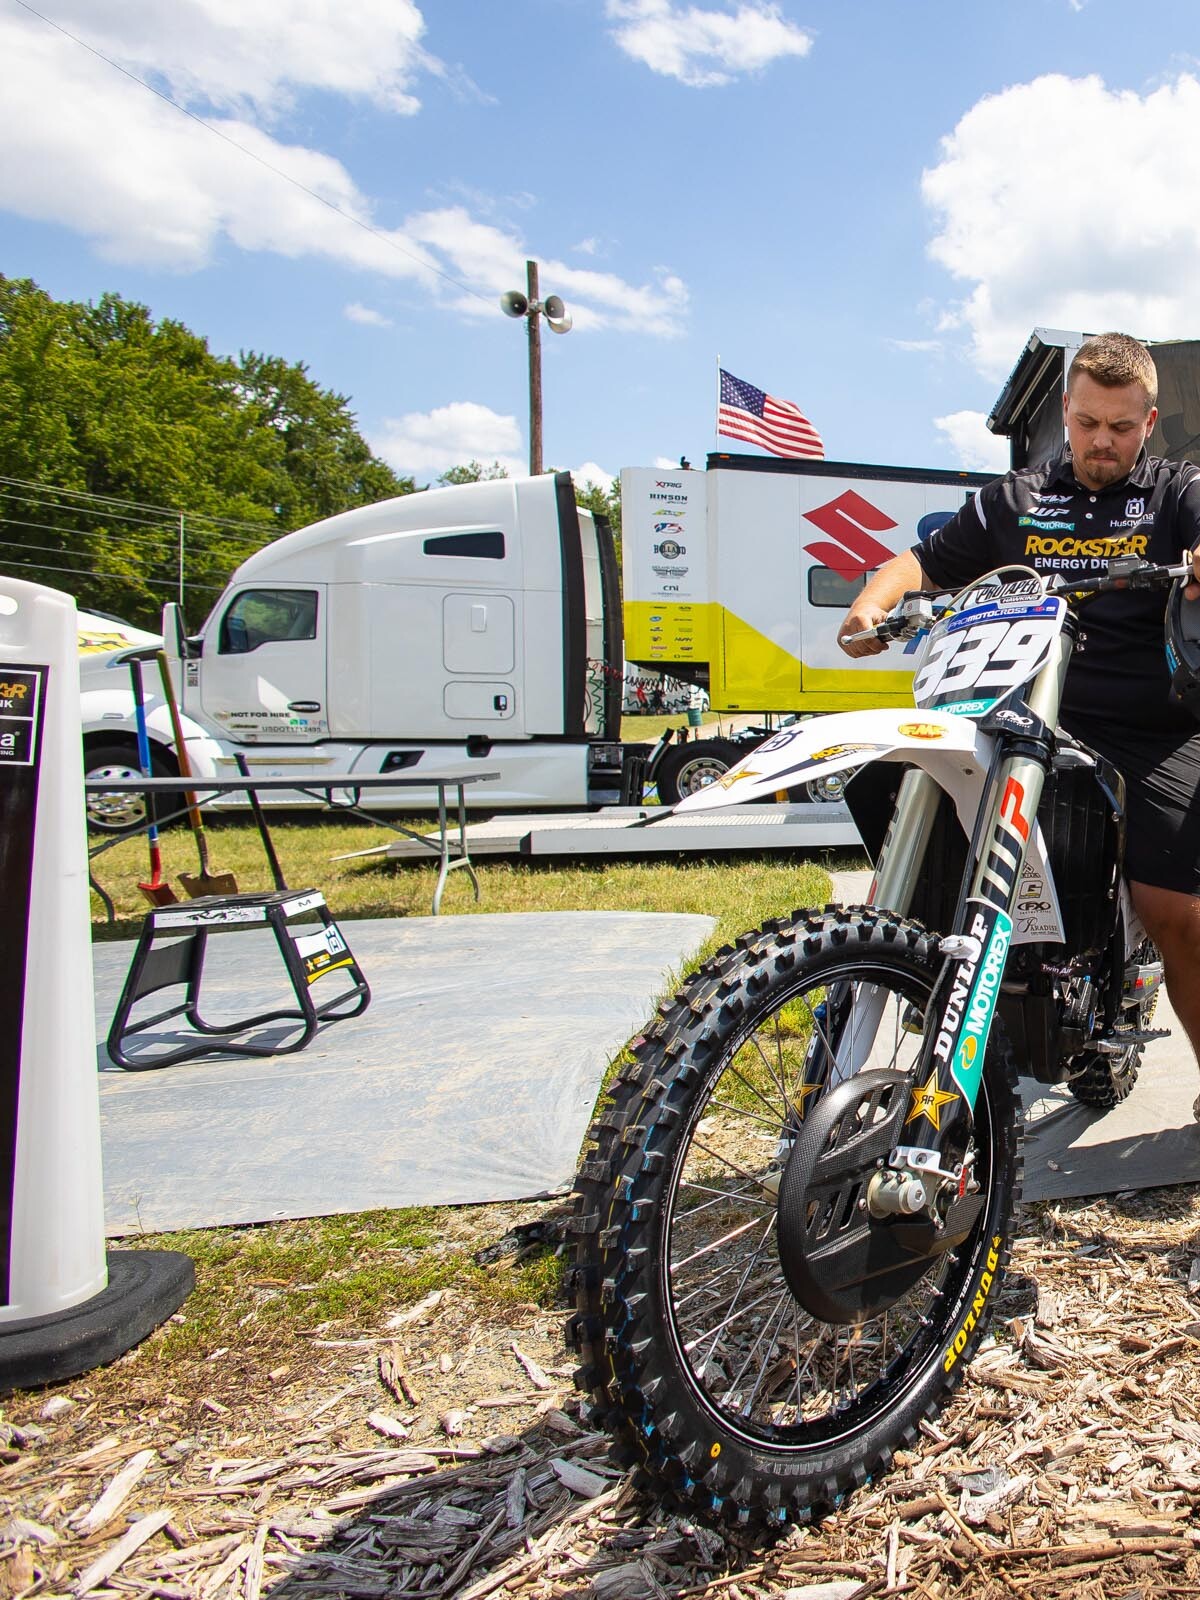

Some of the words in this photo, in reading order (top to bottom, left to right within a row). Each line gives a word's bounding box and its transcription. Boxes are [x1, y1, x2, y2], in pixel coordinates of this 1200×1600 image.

[655, 480, 683, 489] XTRIG
[649, 493, 688, 502] HINSON
[1027, 506, 1071, 517] WP
[1031, 519, 1073, 531] MOTOREX
[1024, 535, 1148, 557] ROCKSTAR
[1034, 557, 1088, 569] ENERGY
[914, 619, 1057, 703] 339
[937, 700, 988, 714] MOTOREX
[1016, 916, 1059, 933] PARADISE
[1041, 963, 1060, 974] Twin
[1060, 966, 1073, 975] Air
[964, 924, 1012, 1036] MOTOREX
[943, 1246, 1000, 1374] DUNLOP
